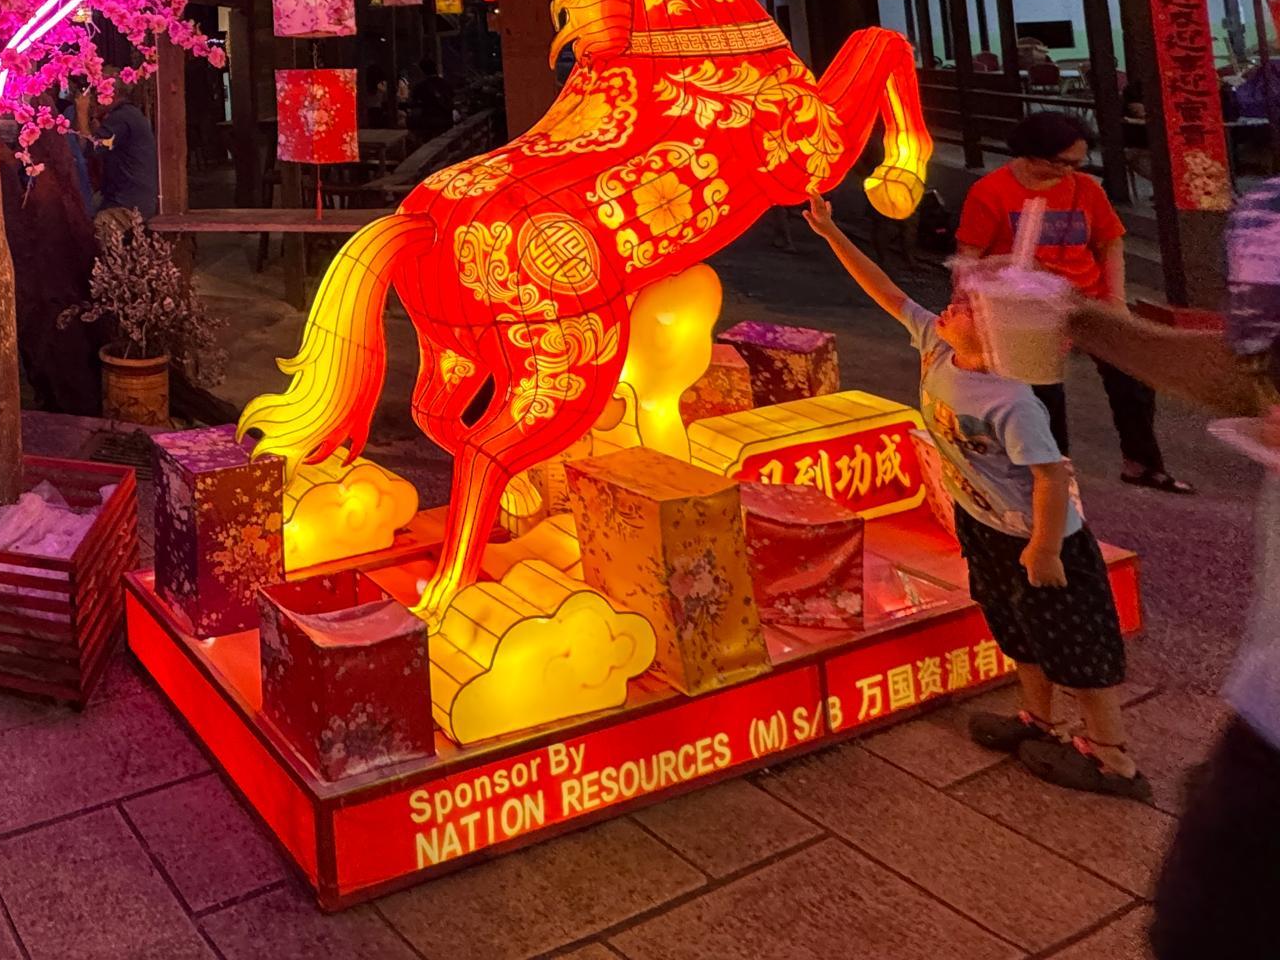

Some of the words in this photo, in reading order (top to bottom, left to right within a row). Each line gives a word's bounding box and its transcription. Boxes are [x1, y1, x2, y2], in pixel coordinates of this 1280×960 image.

[410, 757, 542, 824] Sponsor
[548, 742, 587, 777] By
[417, 791, 545, 869] NATION
[562, 733, 731, 816] RESOURCES
[749, 710, 788, 758] (M)
[793, 696, 843, 740] S/B
